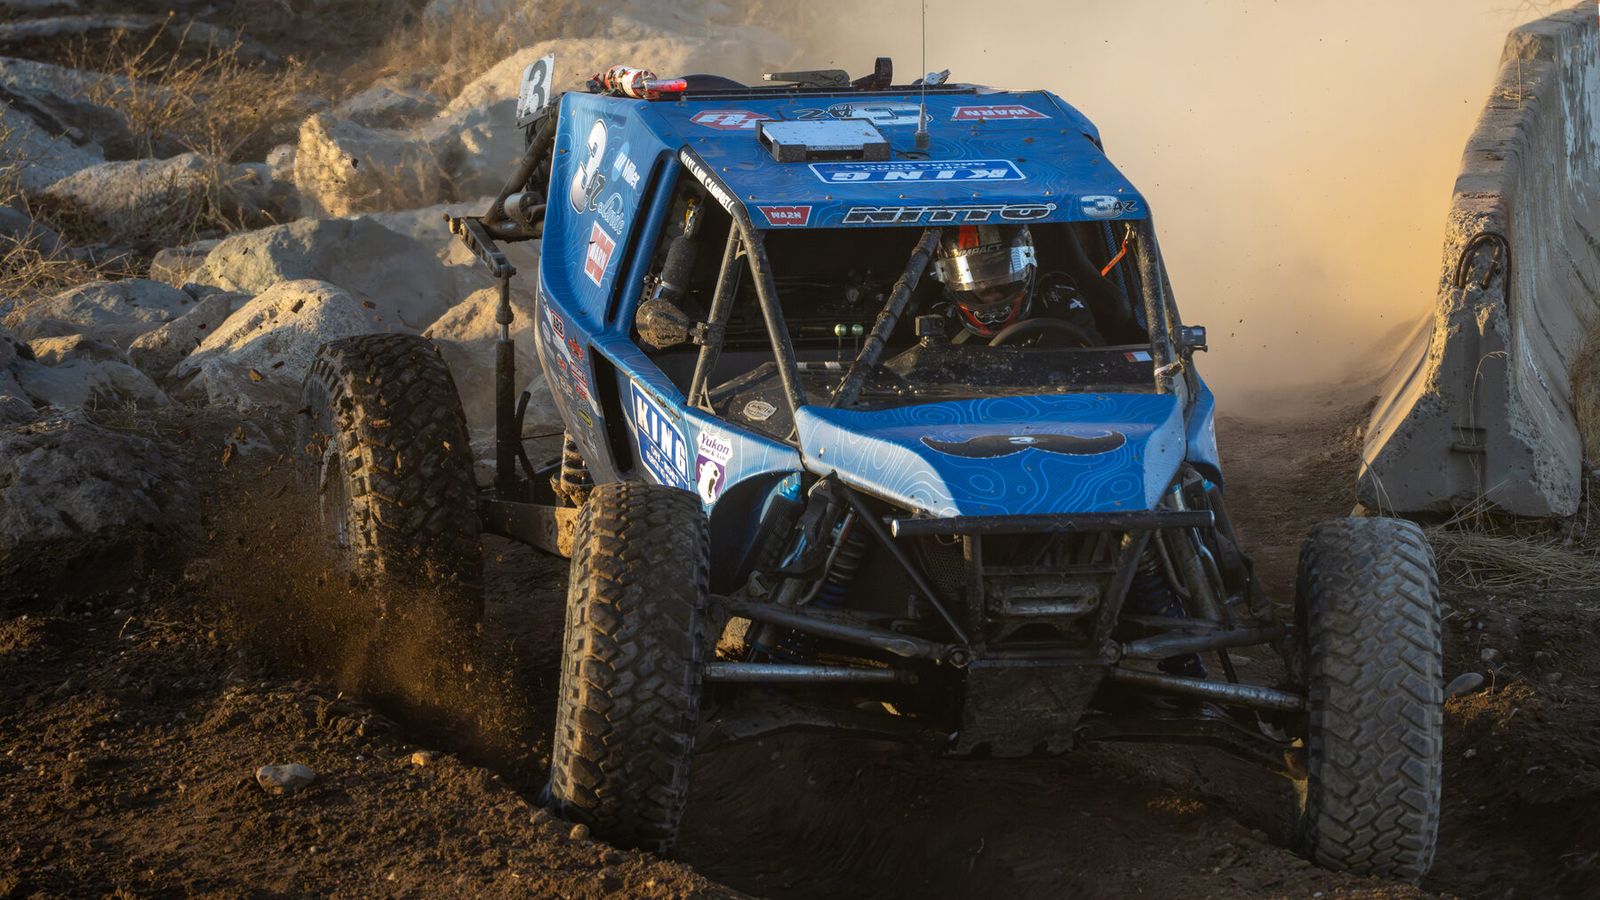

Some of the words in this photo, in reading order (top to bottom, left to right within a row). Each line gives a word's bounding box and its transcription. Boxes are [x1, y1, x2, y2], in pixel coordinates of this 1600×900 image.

[525, 60, 547, 115] 3
[963, 109, 1031, 117] WARN
[570, 119, 608, 214] 3
[831, 169, 1007, 180] KING
[771, 211, 802, 219] WARN
[842, 204, 1052, 224] NITTO
[1080, 195, 1121, 219] 3
[637, 395, 686, 478] KING
[701, 433, 730, 455] Yukon
